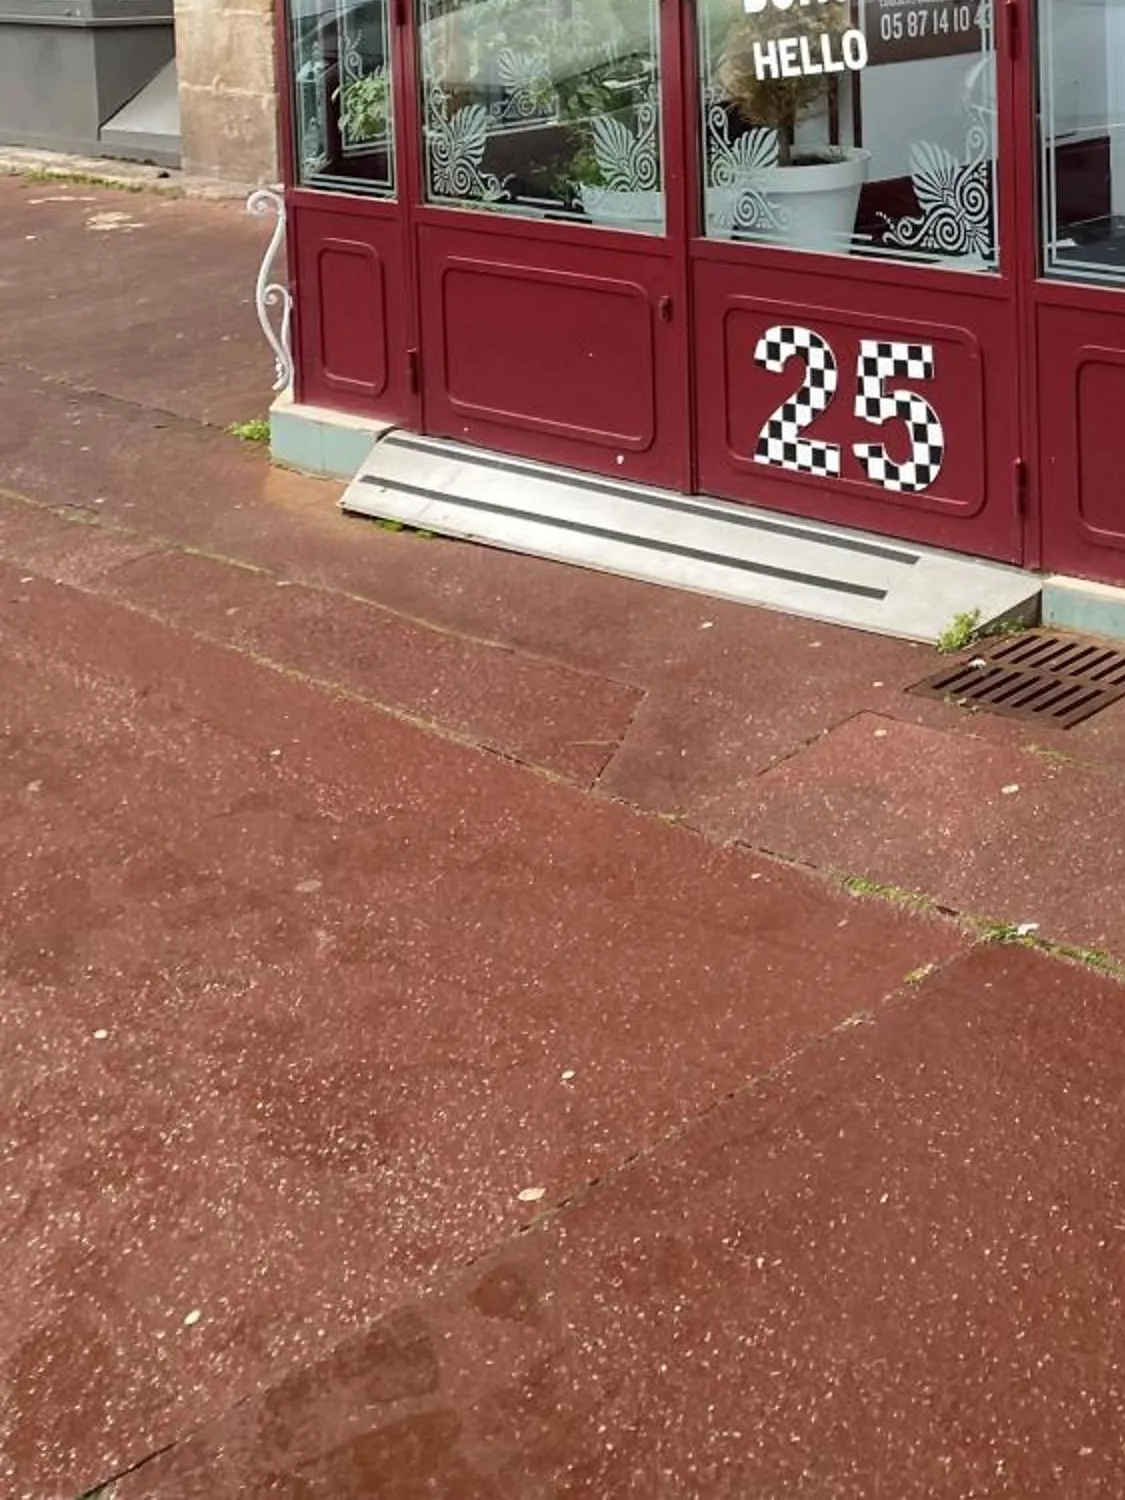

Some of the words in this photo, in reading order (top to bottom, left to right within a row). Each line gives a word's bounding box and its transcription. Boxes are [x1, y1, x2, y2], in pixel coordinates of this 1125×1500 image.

[881, 12, 903, 40] 05
[907, 10, 928, 37] 87
[933, 7, 949, 34] 14
[953, 5, 969, 32] 10
[752, 29, 868, 81] HELLO
[753, 324, 945, 493] 25
